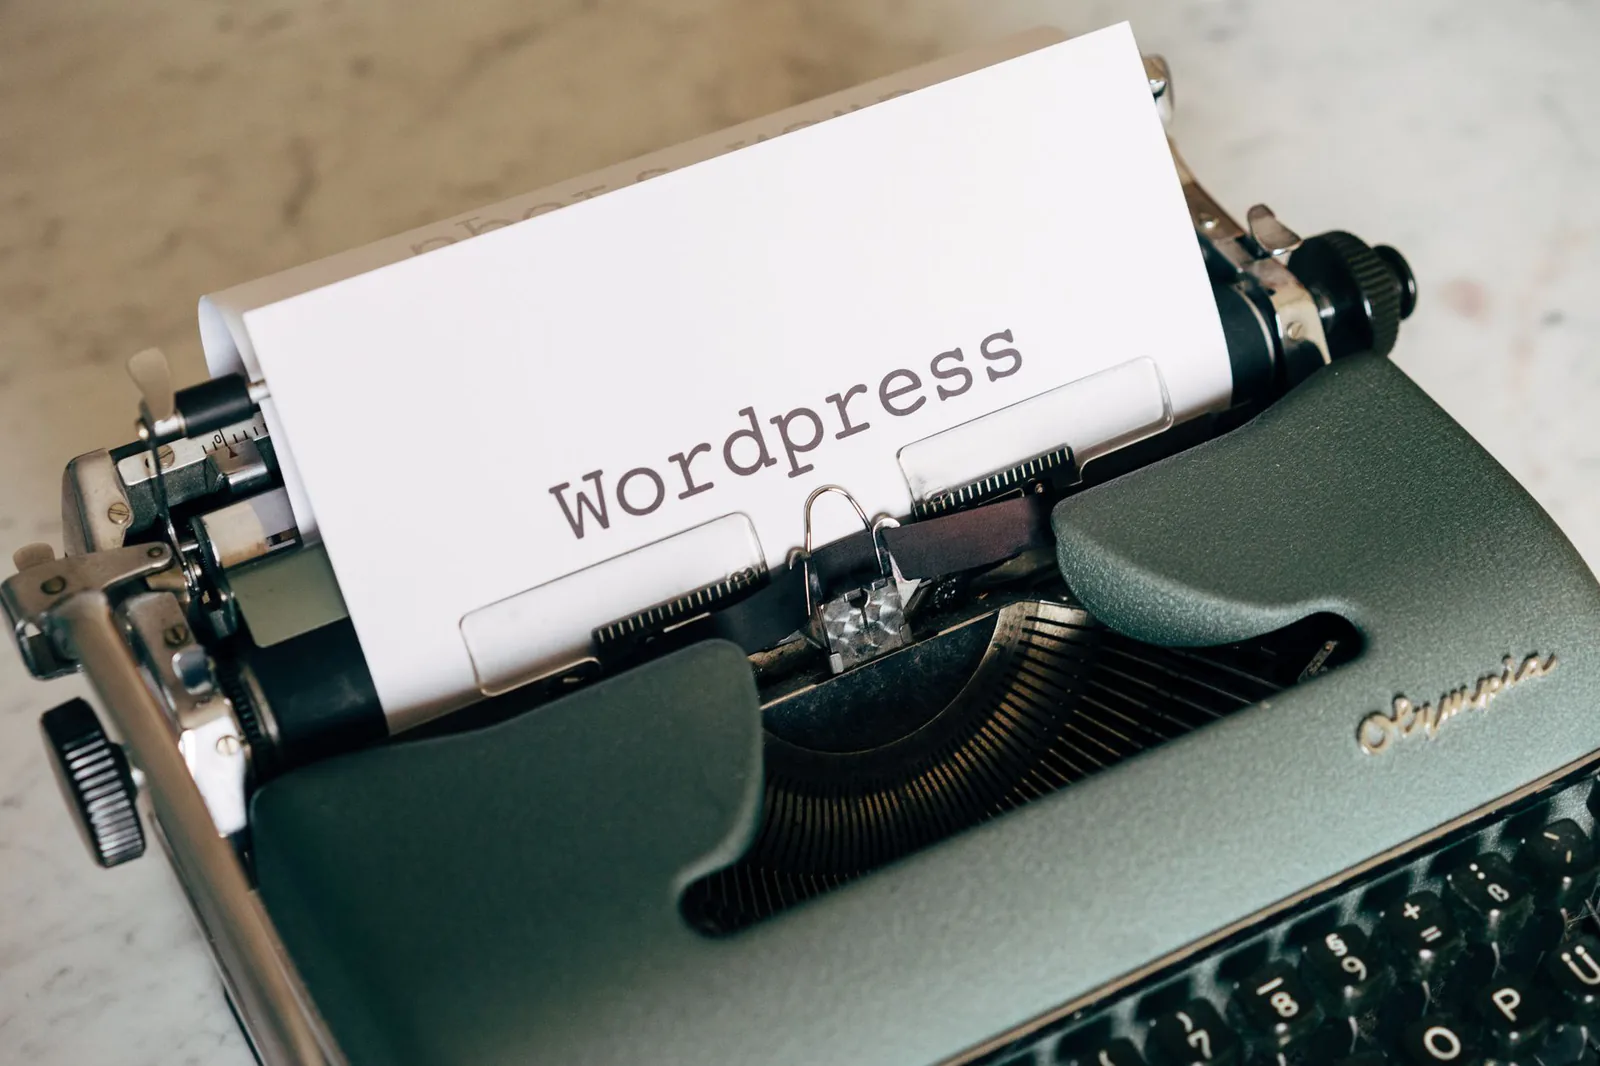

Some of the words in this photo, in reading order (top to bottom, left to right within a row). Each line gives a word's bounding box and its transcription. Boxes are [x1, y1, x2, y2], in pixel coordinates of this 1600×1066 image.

[548, 328, 1023, 540] Wordpress
[1357, 652, 1558, 755] Olympia
[1342, 956, 1367, 981] 9
[1270, 991, 1299, 1017] 8
[1492, 987, 1521, 1022] P
[1187, 1029, 1212, 1059] 7
